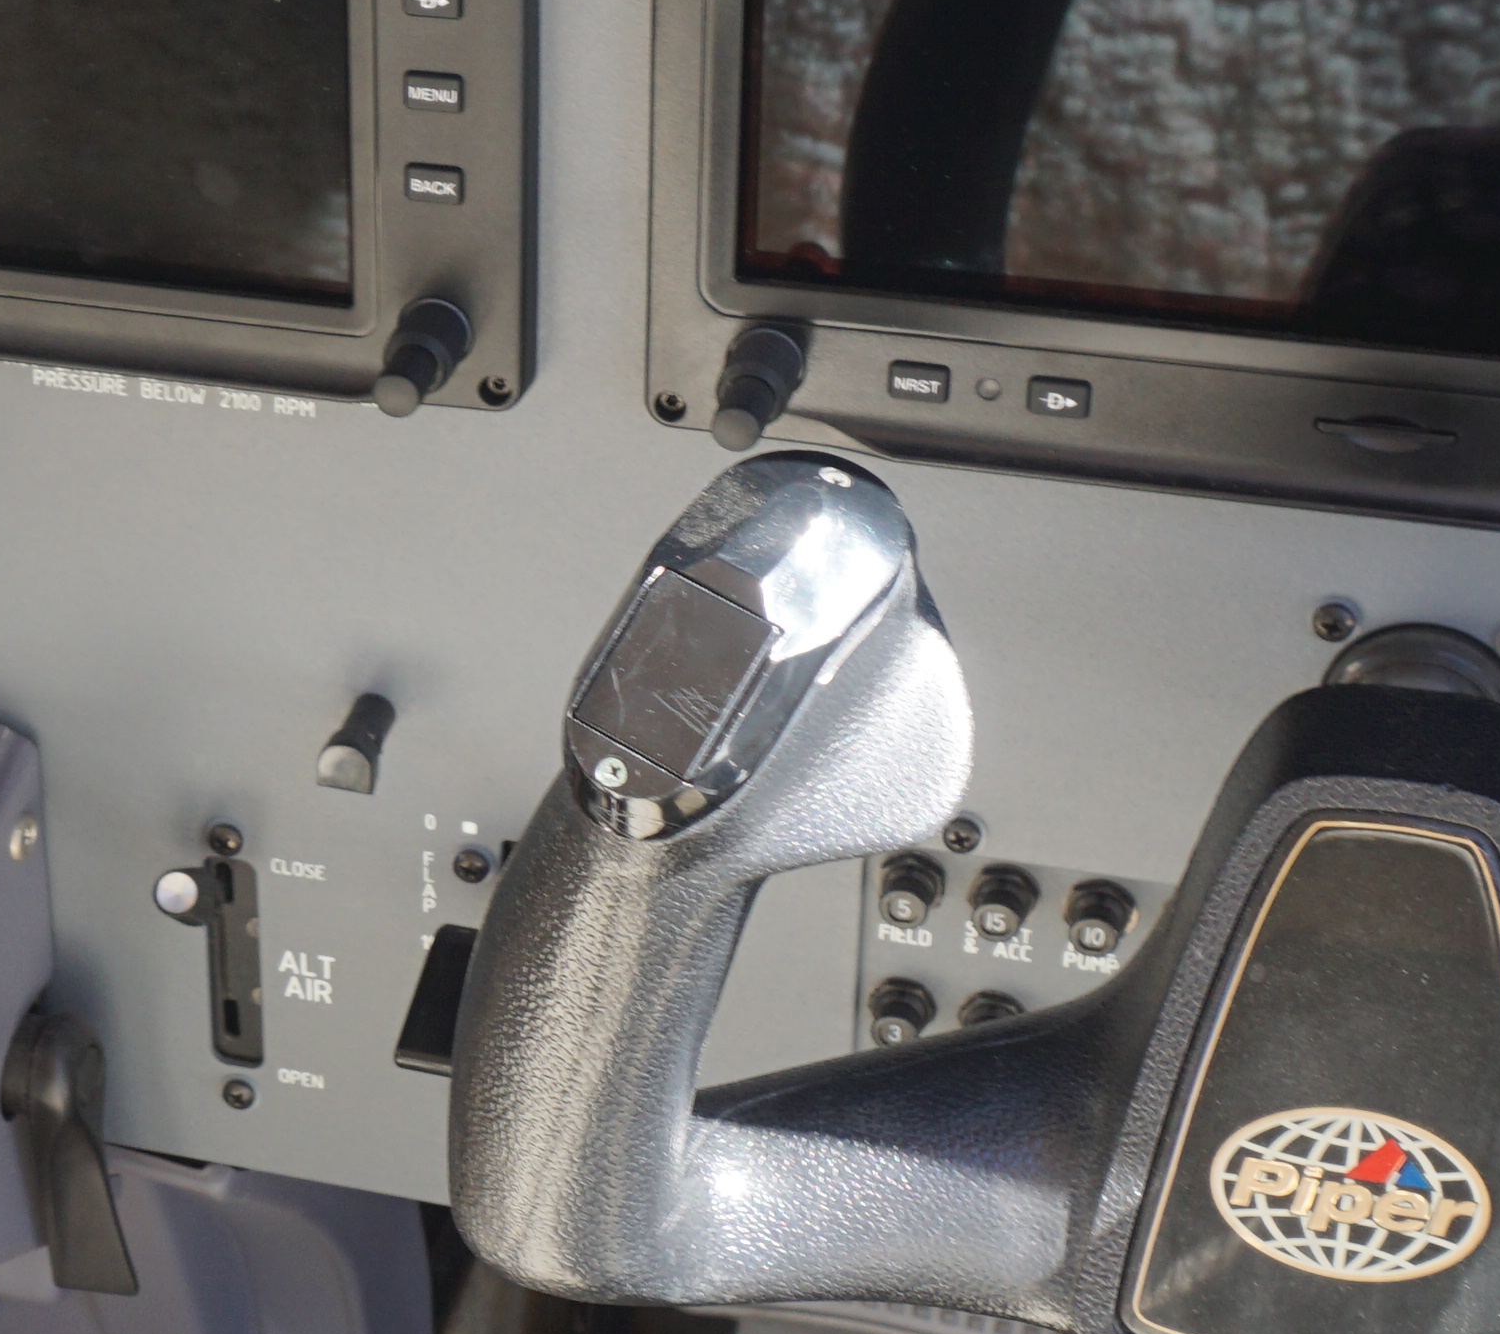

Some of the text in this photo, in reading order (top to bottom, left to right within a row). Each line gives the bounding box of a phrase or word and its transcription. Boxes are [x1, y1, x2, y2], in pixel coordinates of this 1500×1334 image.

[407, 86, 458, 104] MENU
[410, 178, 457, 197] BACK
[32, 368, 128, 397] PRESSURE
[140, 380, 206, 405] BELOW
[219, 390, 261, 412] 2100
[273, 396, 316, 418] RPM
[894, 375, 942, 395] NRST
[269, 857, 327, 881] CLOSE
[421, 851, 438, 913] FLAP
[897, 898, 912, 919] 5
[984, 910, 1007, 930] 15
[878, 924, 933, 948] FIELD
[1084, 925, 1106, 944] 10
[992, 942, 1033, 963] ACC
[1062, 951, 1121, 975] PUMP
[278, 950, 337, 980] ALT
[284, 975, 333, 1005] AIR
[277, 1068, 326, 1090] OPEN
[1229, 1156, 1478, 1238] Piper
